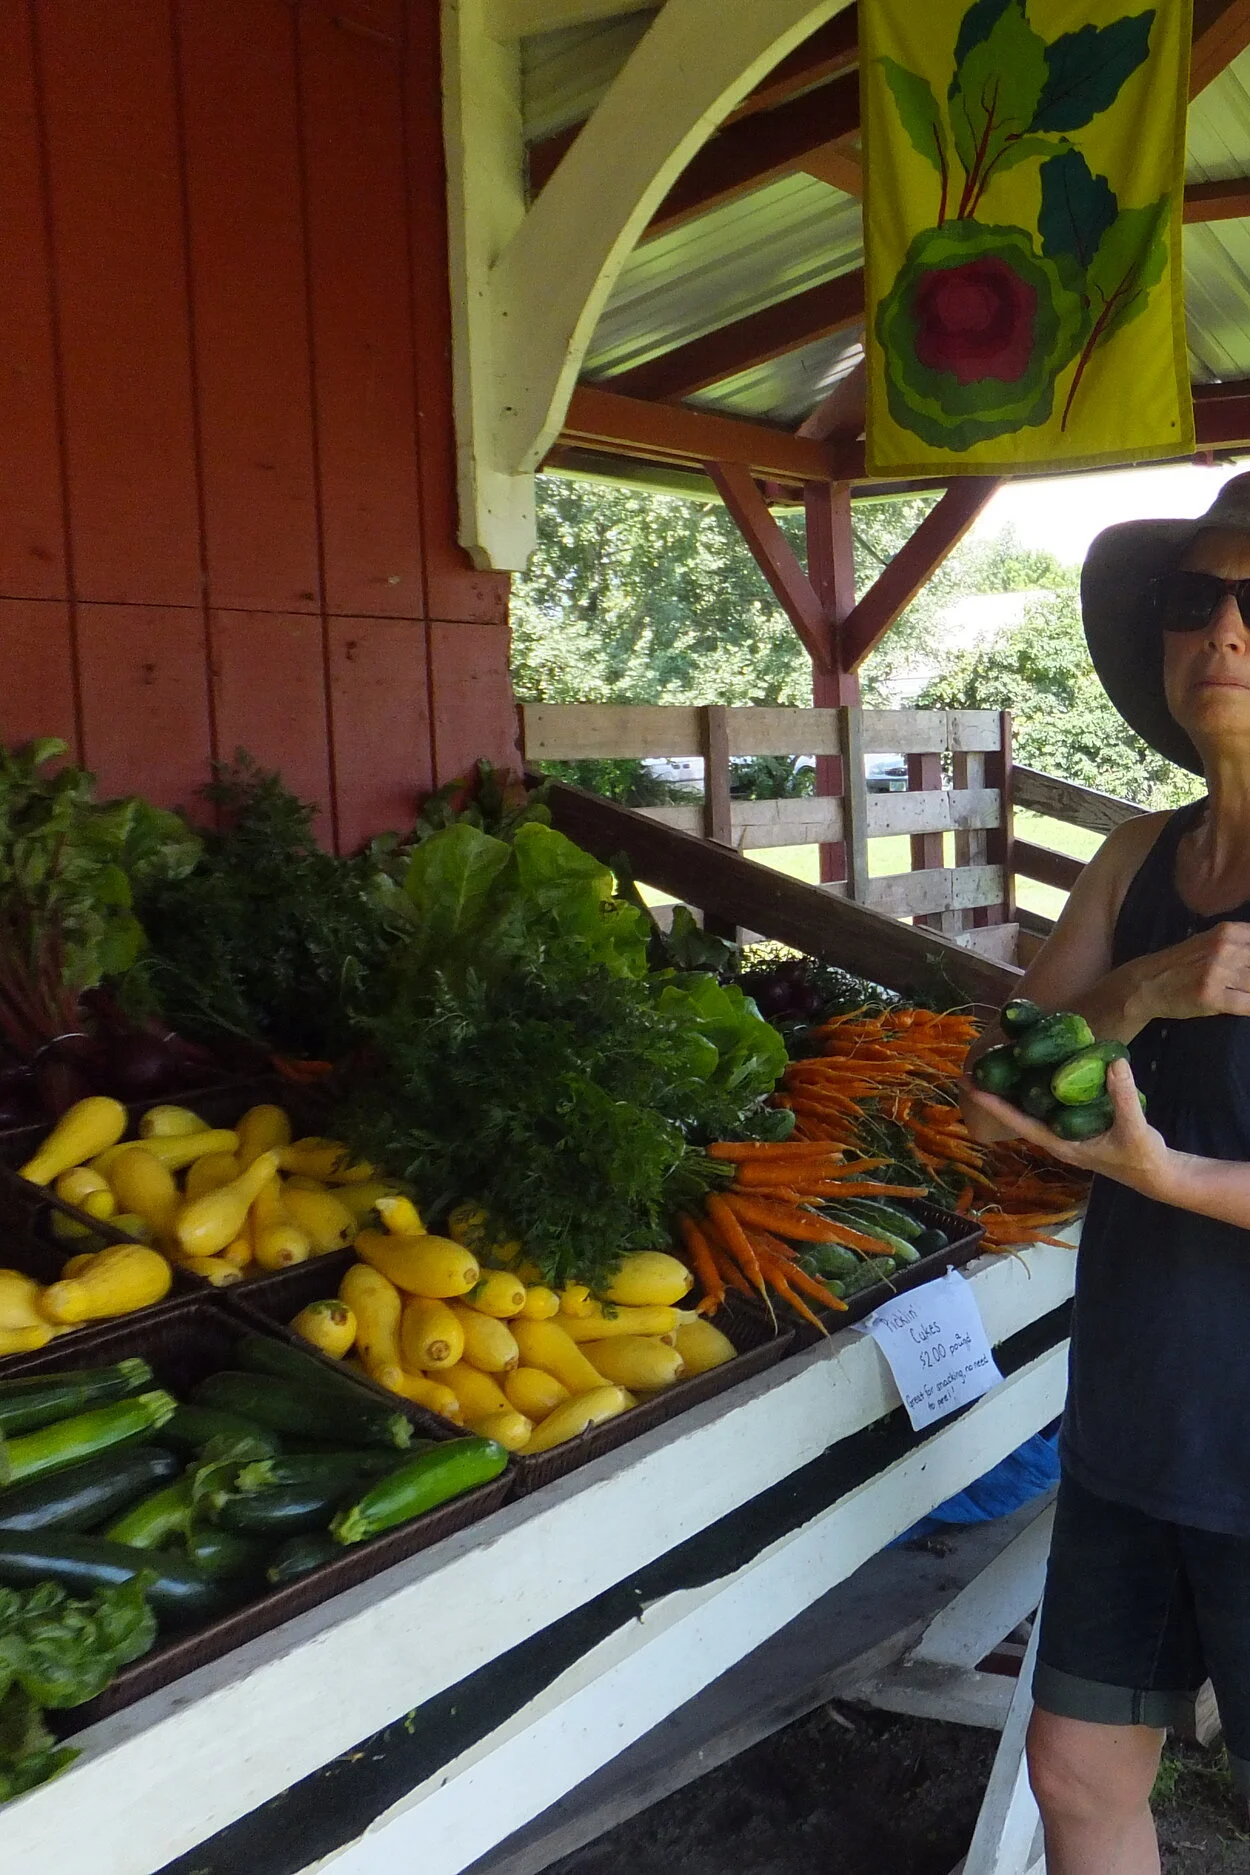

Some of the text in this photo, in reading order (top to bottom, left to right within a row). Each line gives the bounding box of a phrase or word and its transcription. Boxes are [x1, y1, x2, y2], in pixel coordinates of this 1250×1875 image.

[909, 1321, 941, 1344] Cukes
[919, 1343, 946, 1370] $2.00
[949, 1332, 972, 1356] pound
[905, 1390, 925, 1408] Great
[923, 1384, 934, 1397] for
[965, 1364, 974, 1372] no
[973, 1354, 989, 1368] need
[927, 1401, 936, 1410] to
